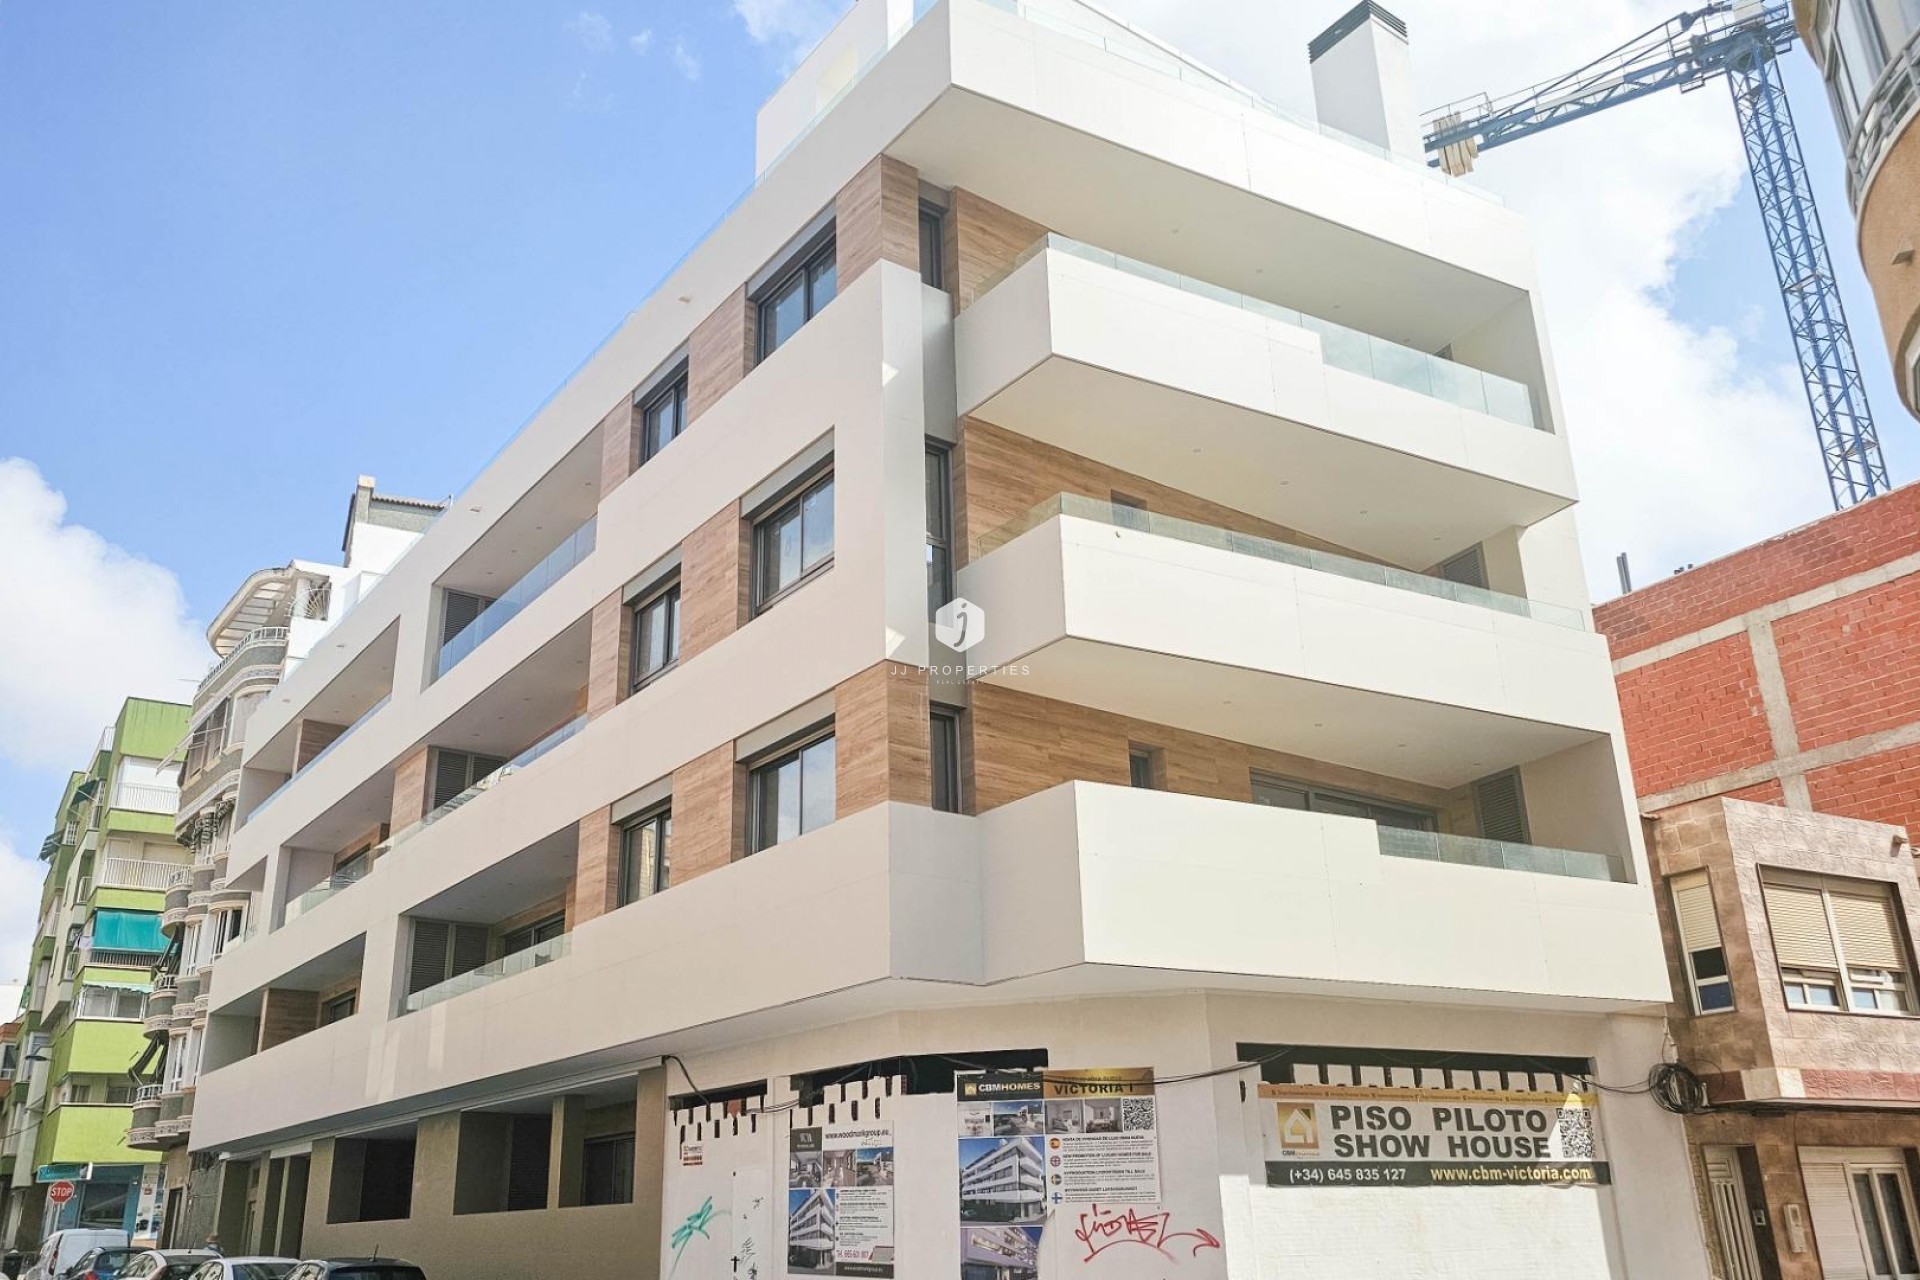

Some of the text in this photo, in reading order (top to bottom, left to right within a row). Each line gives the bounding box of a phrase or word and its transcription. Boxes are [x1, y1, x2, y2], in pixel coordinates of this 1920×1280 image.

[978, 1082, 1041, 1092] CBMHOMES
[1053, 1082, 1124, 1096] VICTORIA
[1330, 1105, 1547, 1133] PISO PILOTO
[1334, 1133, 1551, 1159] SHOW HOUSE
[1289, 1164, 1592, 1183] (+34) 645 835 127 www.cbm-victoria.com
[51, 1187, 73, 1197] STOP
